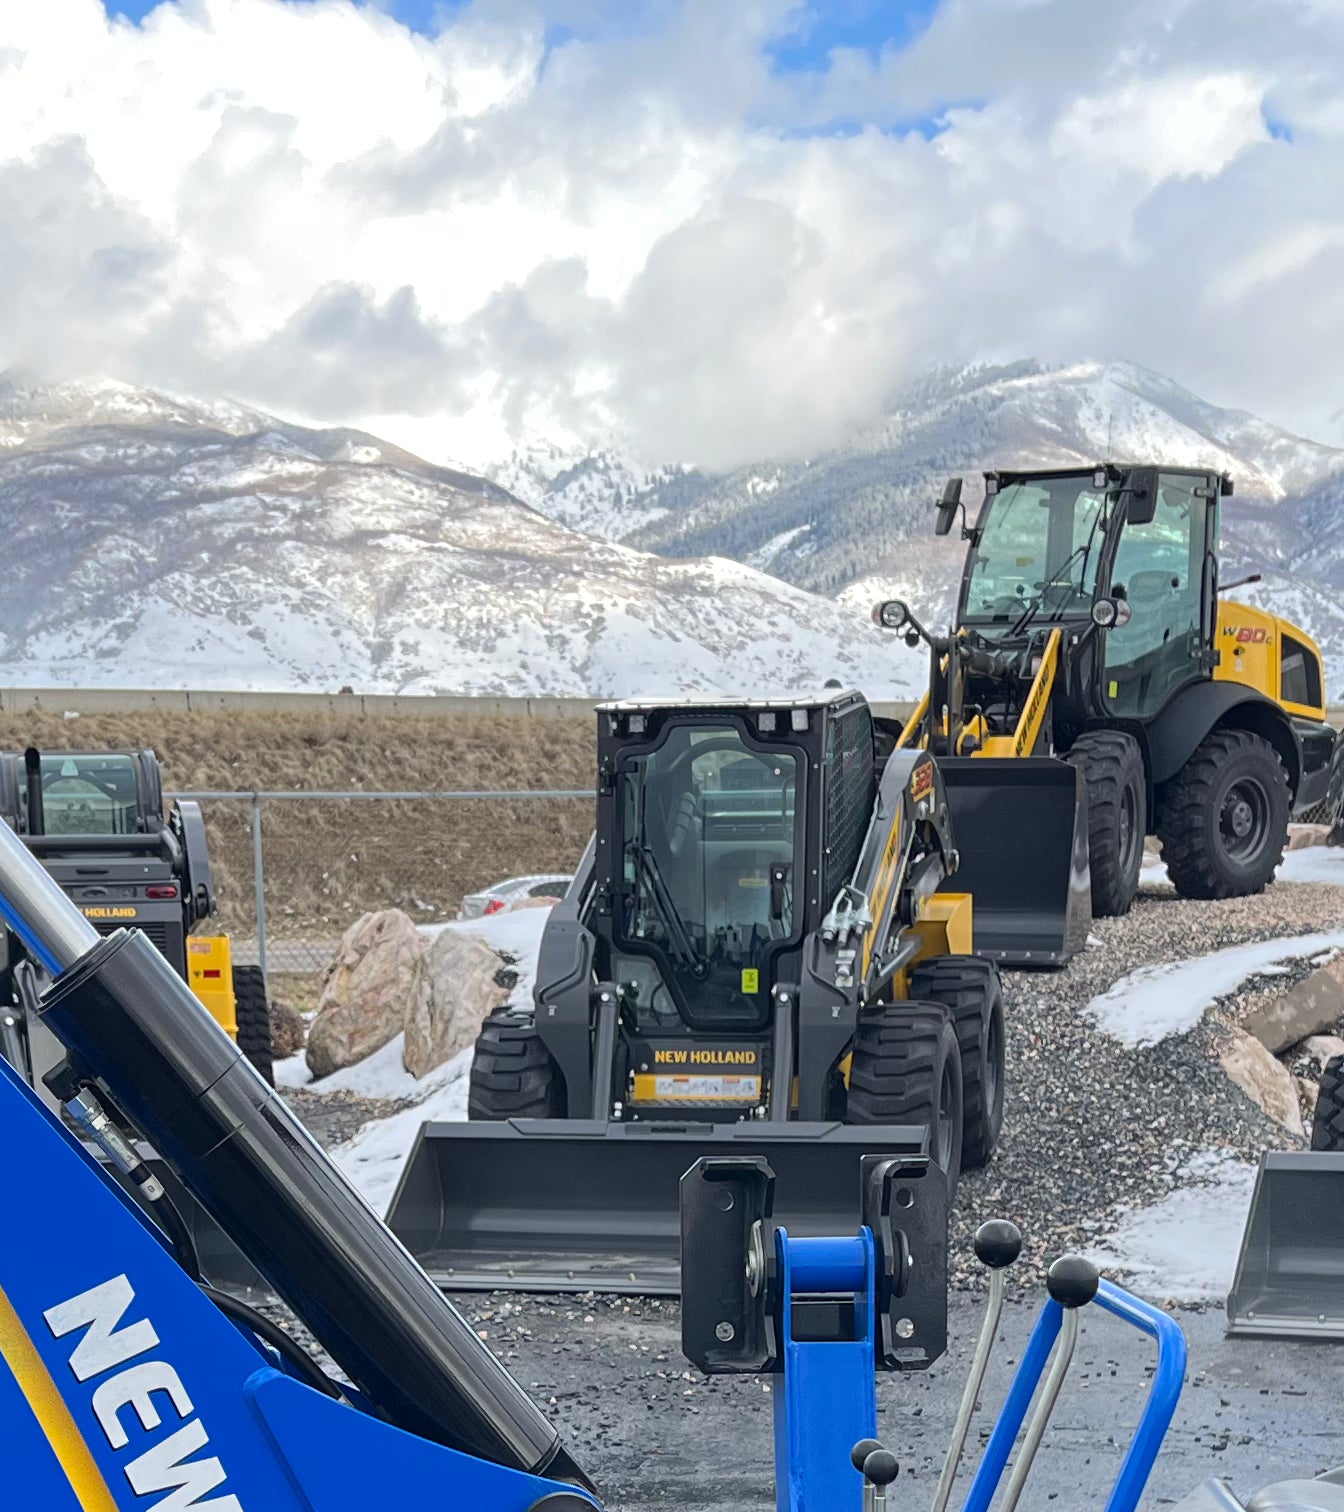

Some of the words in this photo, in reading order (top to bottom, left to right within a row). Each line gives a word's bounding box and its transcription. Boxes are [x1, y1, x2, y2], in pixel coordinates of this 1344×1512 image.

[85, 907, 137, 918] HOLLAND
[655, 1050, 687, 1064] NEW
[690, 1050, 756, 1065] HOLLAND
